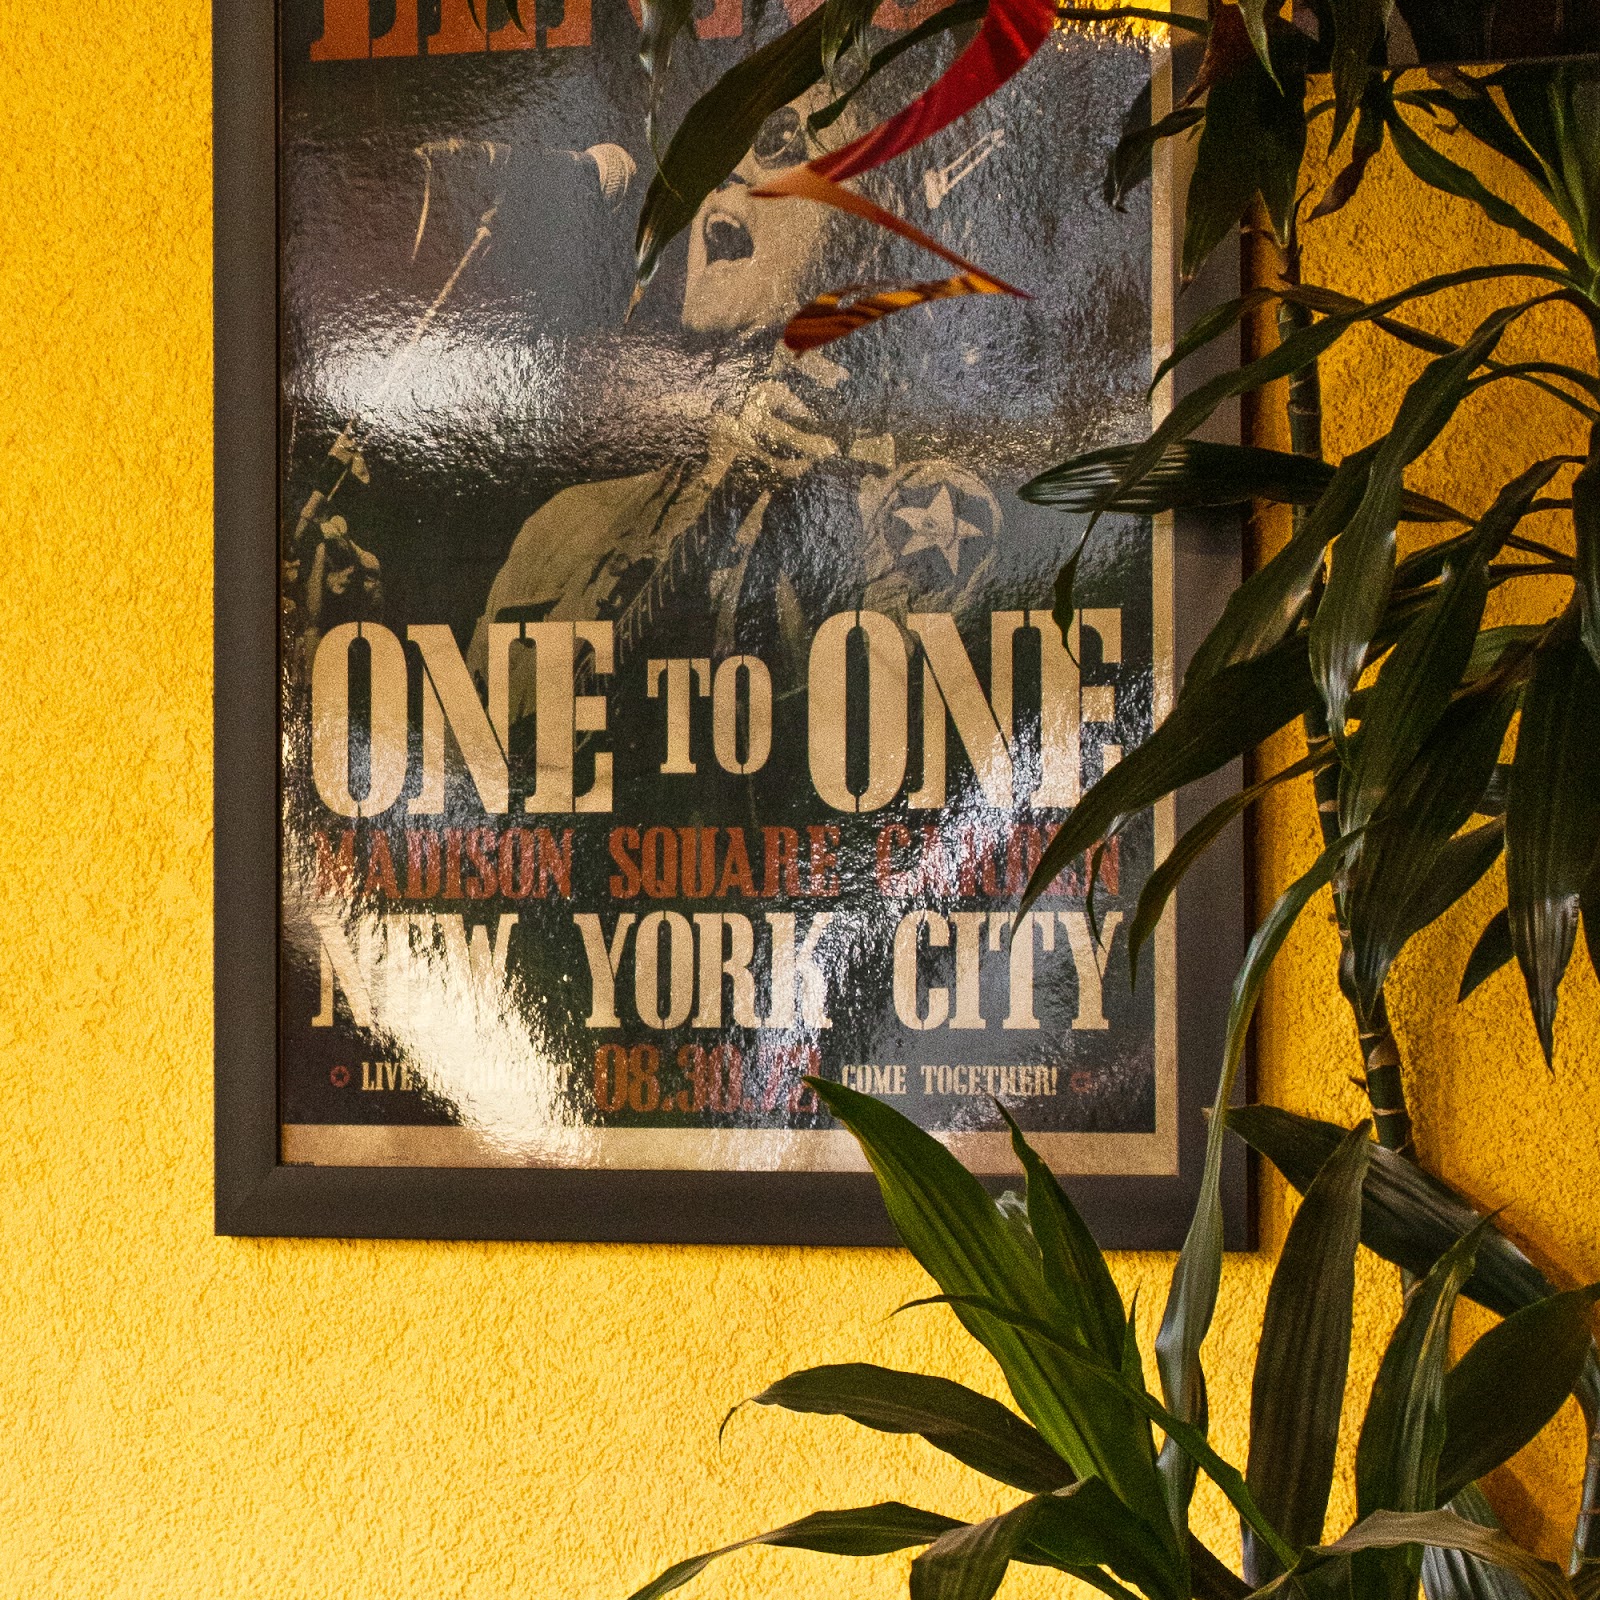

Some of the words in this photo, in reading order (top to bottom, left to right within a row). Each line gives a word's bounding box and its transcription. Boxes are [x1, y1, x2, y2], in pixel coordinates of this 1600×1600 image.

[311, 620, 613, 818] ONE
[647, 654, 774, 776] TO
[807, 607, 1123, 815] ONE
[314, 826, 574, 900] MADISON
[608, 823, 841, 898] SQUARE
[310, 912, 519, 1028] NEW
[574, 910, 832, 1030] YORK
[892, 908, 1123, 1031] CITY
[360, 1061, 413, 1092] LIVE
[593, 1043, 822, 1114] 08.30.72
[841, 1064, 907, 1095] COME
[919, 1063, 1058, 1097] TOGETHER!
